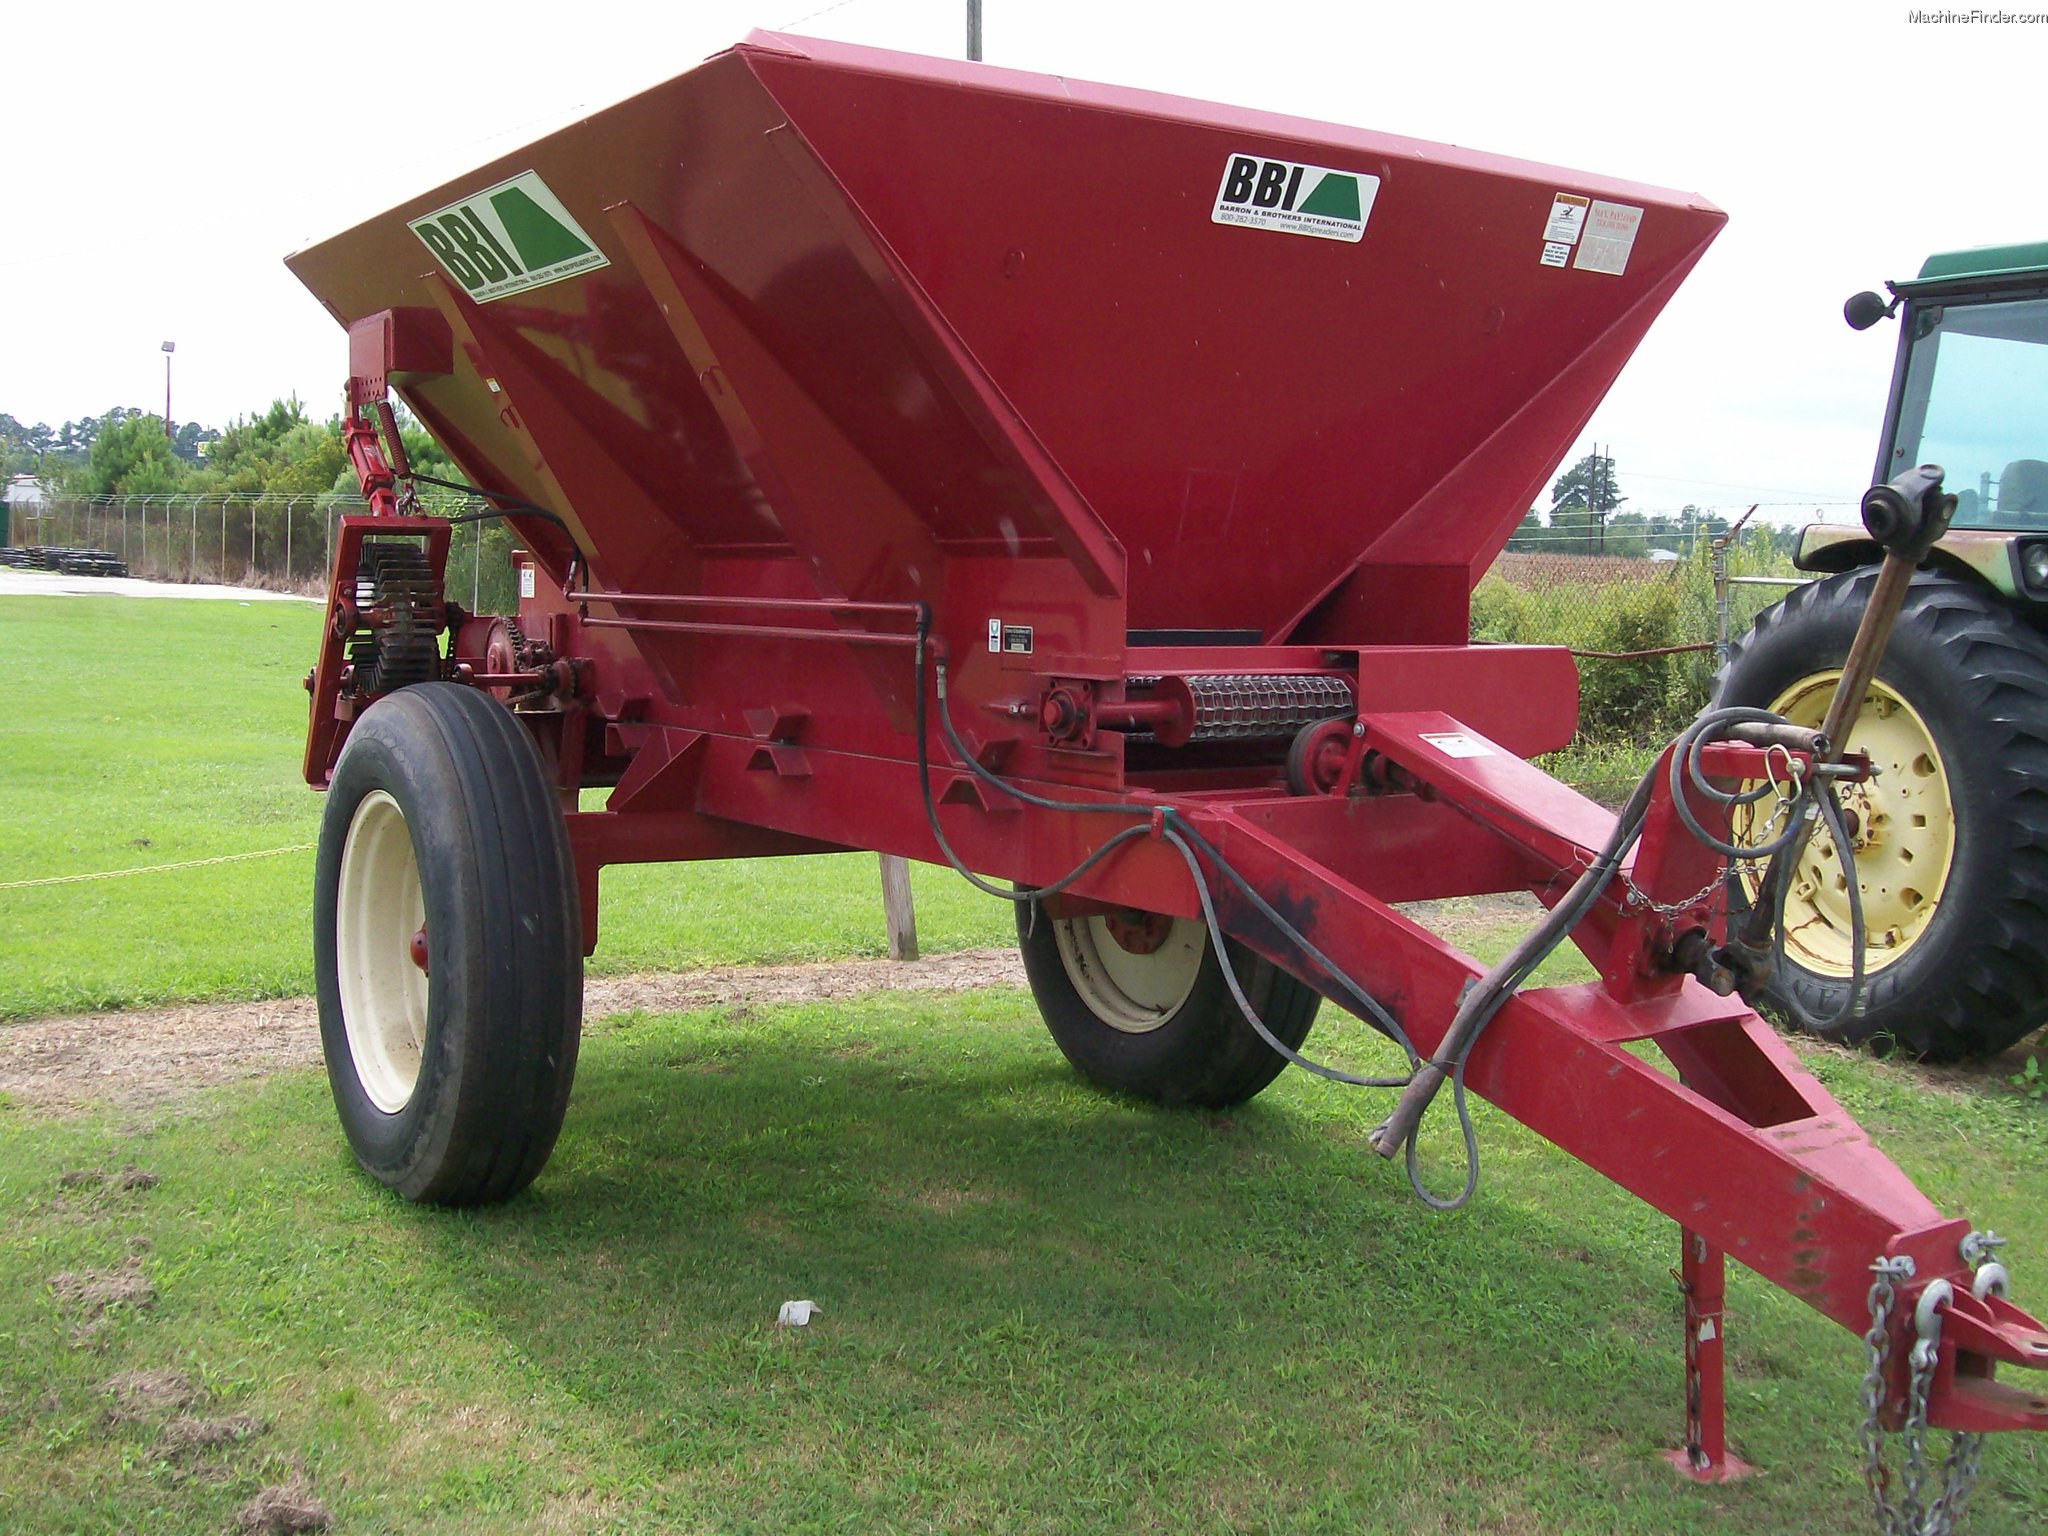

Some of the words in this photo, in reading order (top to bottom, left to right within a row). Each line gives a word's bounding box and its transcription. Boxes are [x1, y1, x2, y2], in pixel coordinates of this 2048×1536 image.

[1222, 157, 1304, 211] BBI
[1219, 205, 1251, 214] BARRON
[1261, 211, 1302, 221] BROTHERS
[1304, 217, 1362, 230] INTERNATIONAL
[415, 205, 524, 290] BBI
